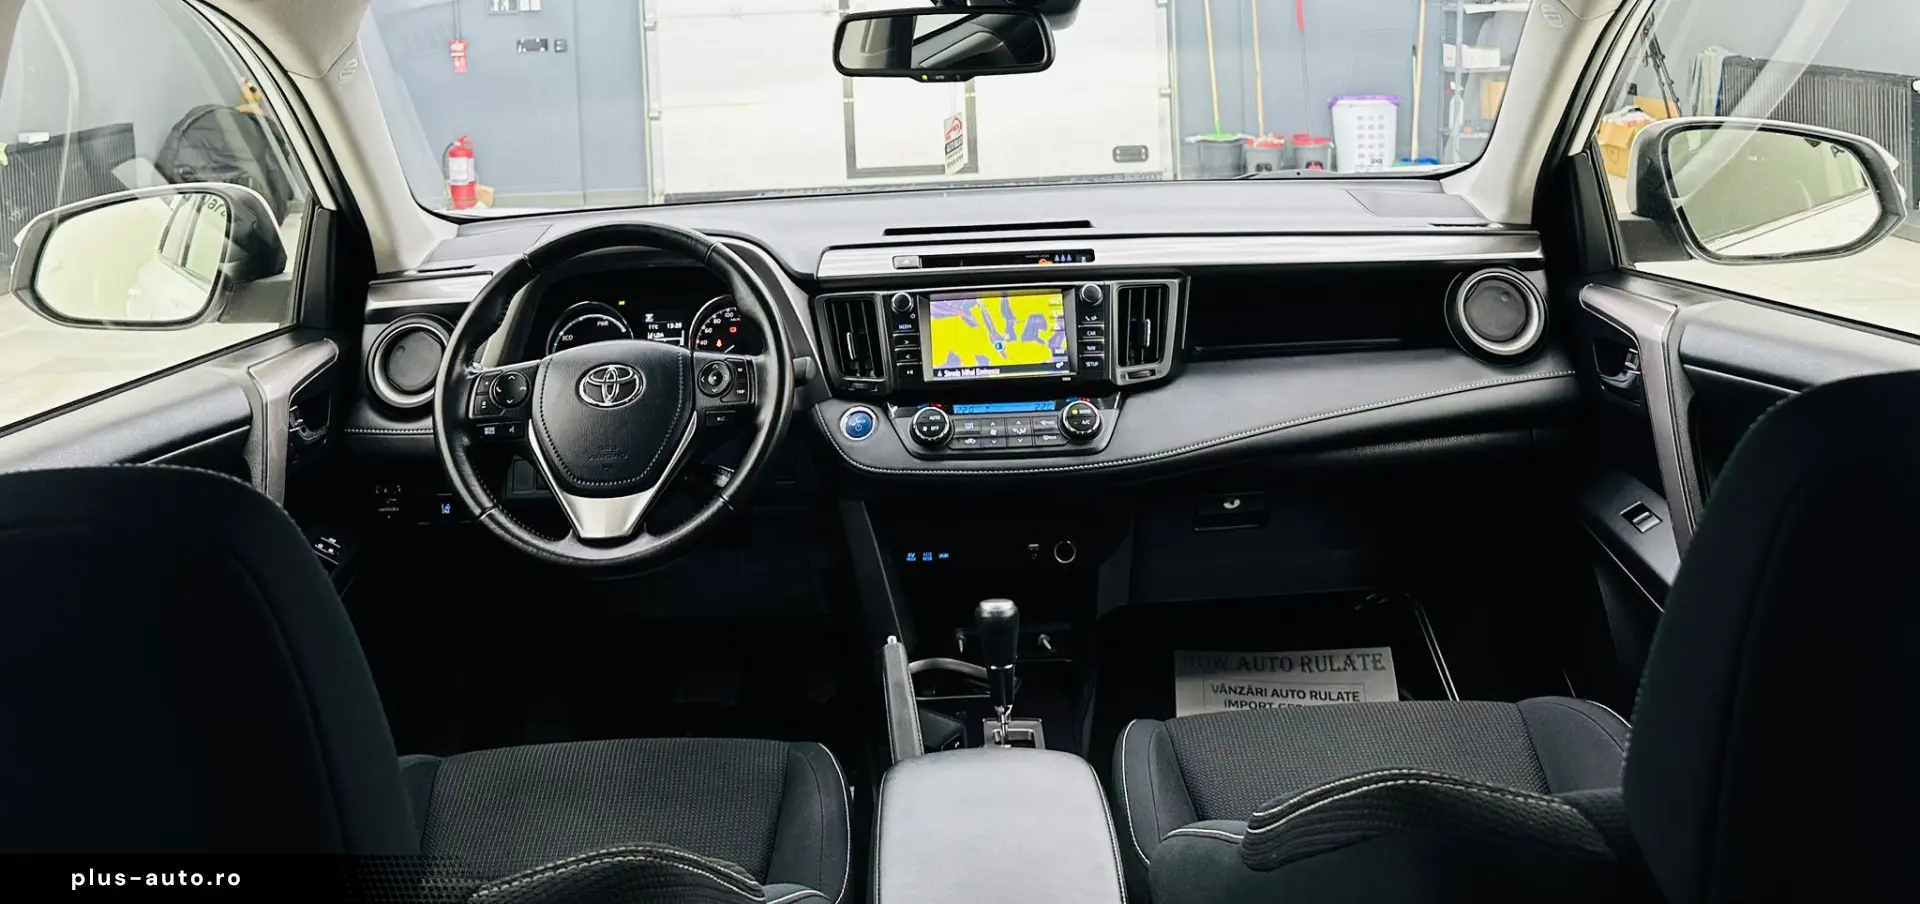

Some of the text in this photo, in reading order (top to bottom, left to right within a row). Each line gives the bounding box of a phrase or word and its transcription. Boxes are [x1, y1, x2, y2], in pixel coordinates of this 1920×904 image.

[1235, 654, 1294, 673] AUTO
[1299, 652, 1386, 674] RULATE
[1211, 682, 1360, 702] VÂNZĂRI AUTO RULATE
